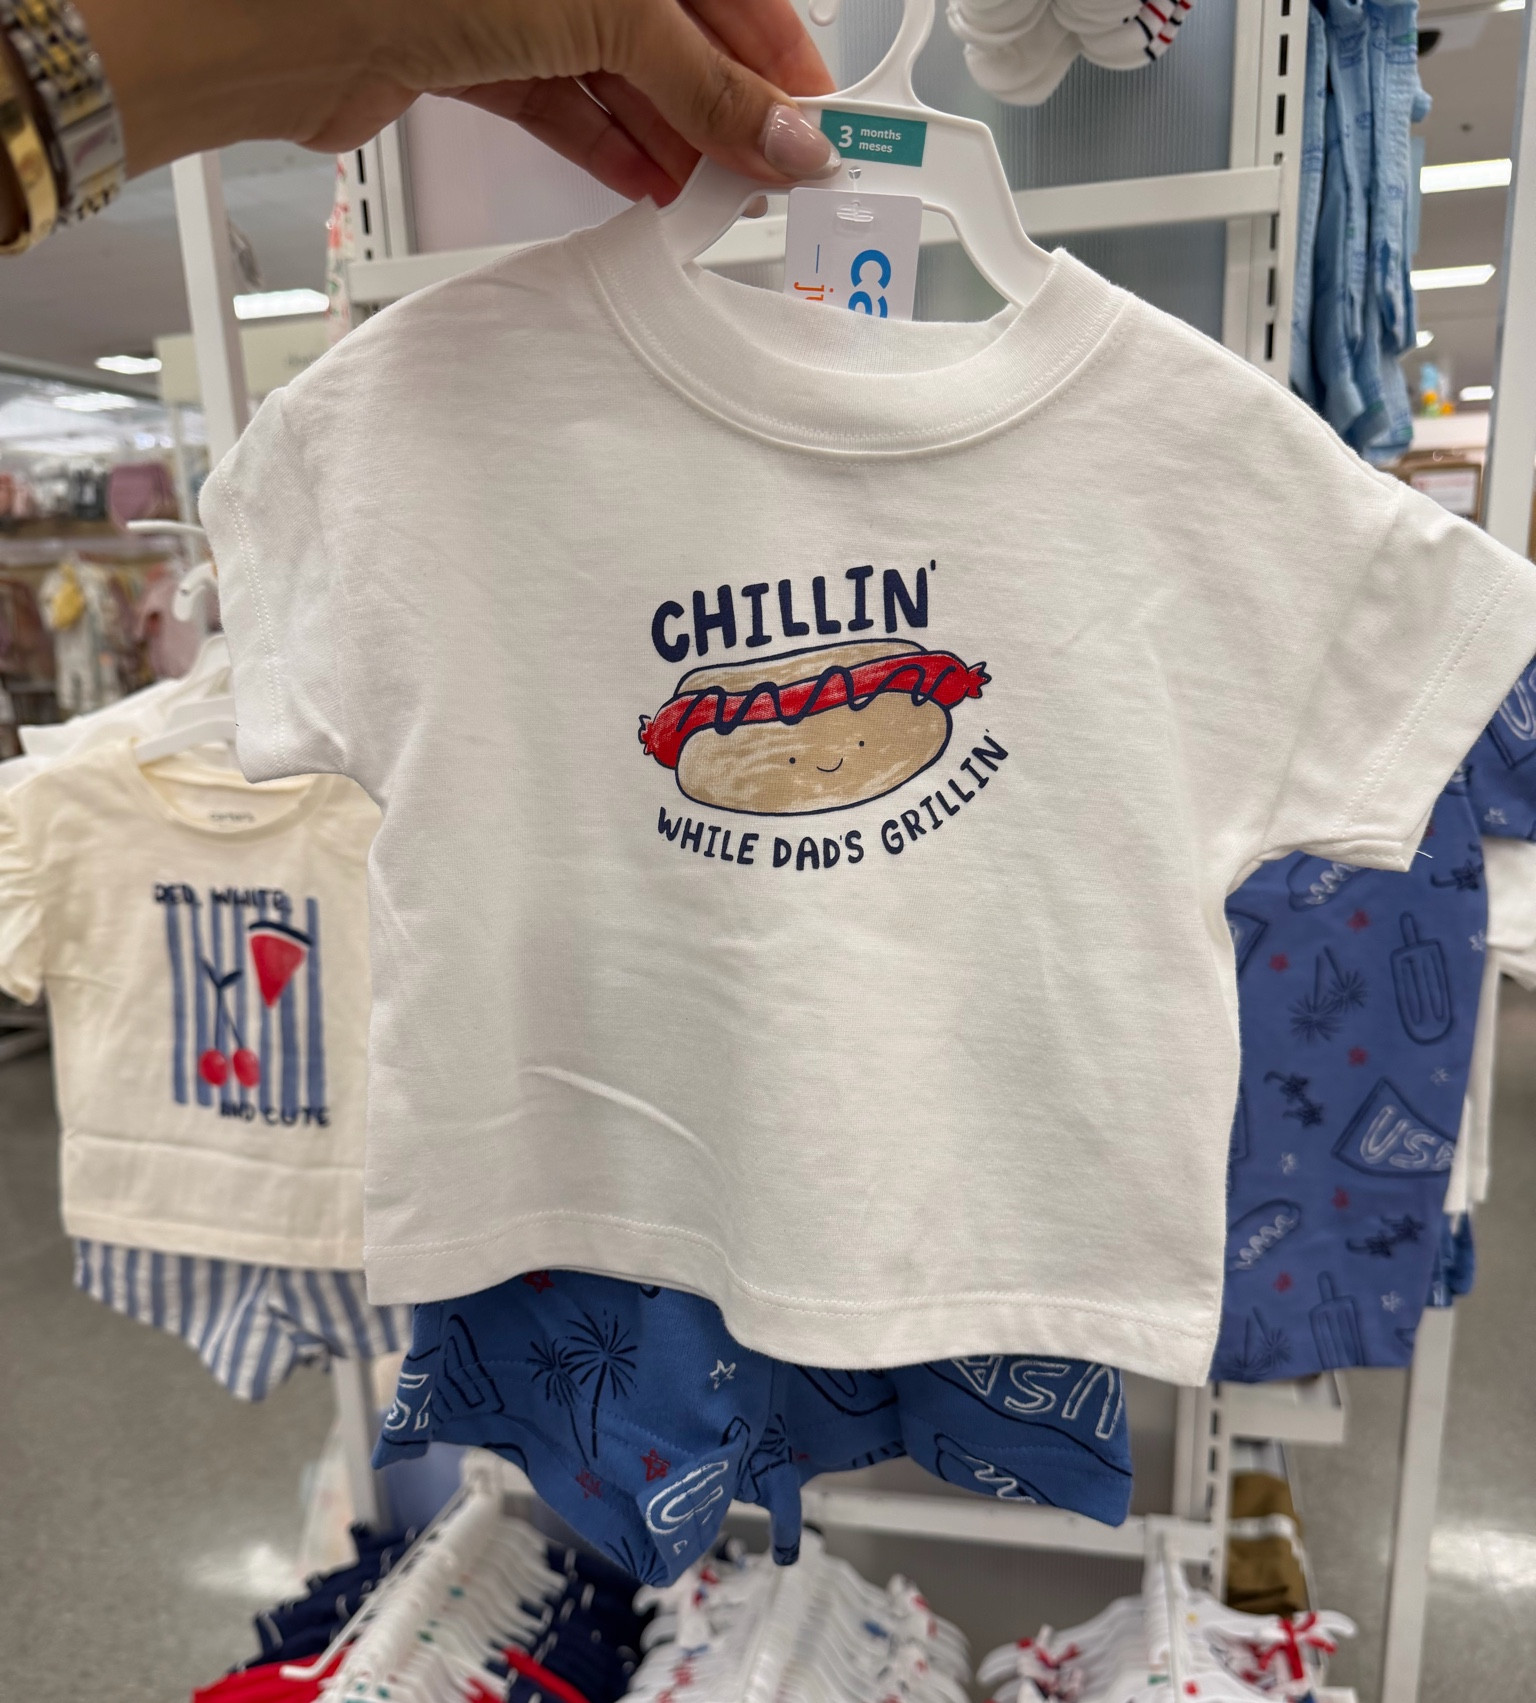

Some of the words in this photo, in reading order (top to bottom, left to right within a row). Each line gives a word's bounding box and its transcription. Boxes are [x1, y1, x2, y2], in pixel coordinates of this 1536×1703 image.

[838, 125, 853, 148] 3
[860, 128, 902, 141] months
[858, 141, 893, 153] meses
[651, 559, 937, 663] CHILLIN'
[657, 806, 760, 866] WHILE
[772, 829, 865, 872] DAD'S
[880, 728, 1009, 855] GRILLIN'
[261, 1106, 331, 1127] CUTE
